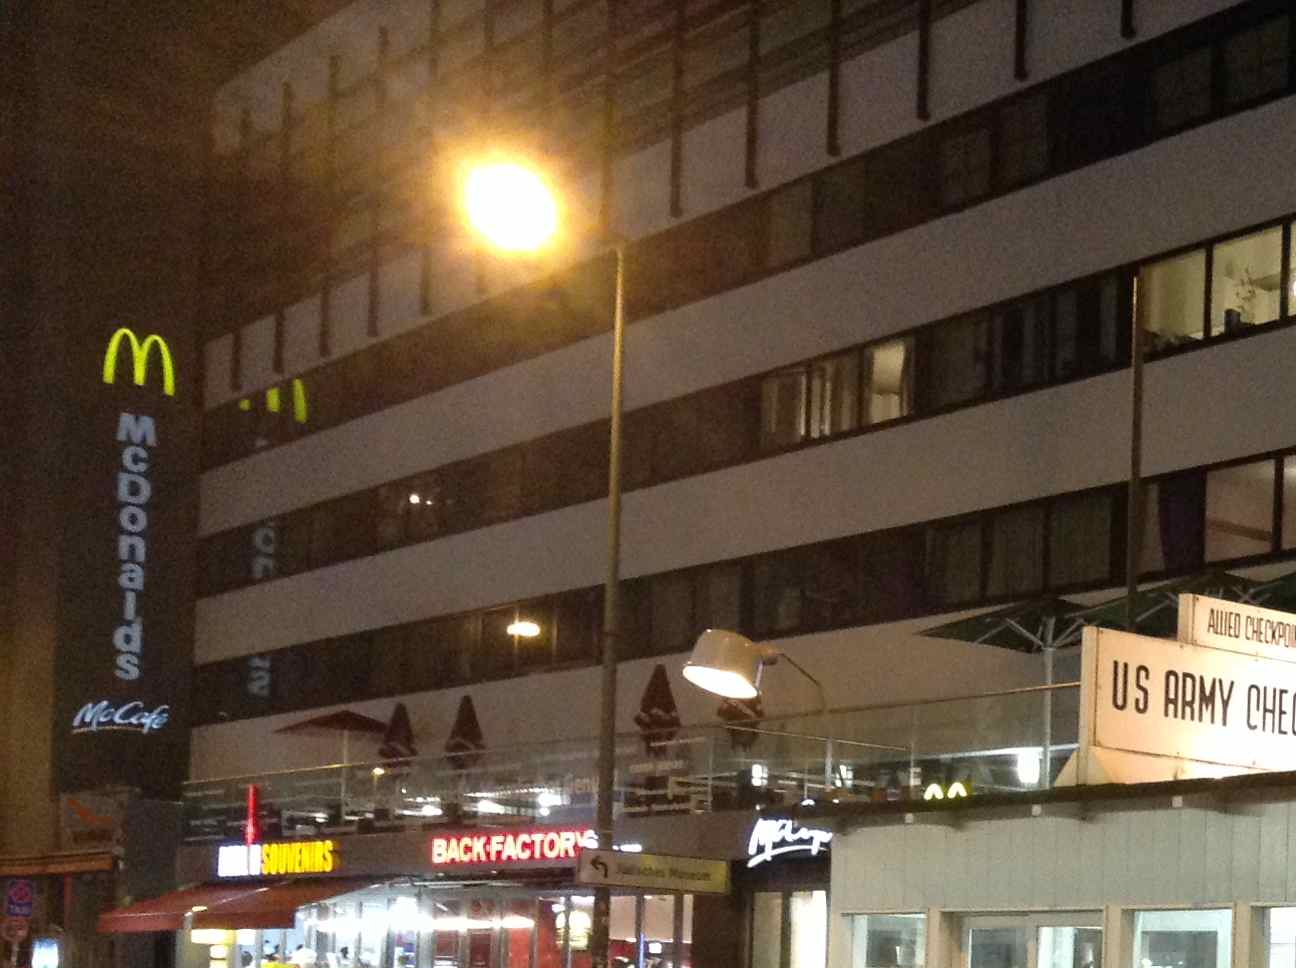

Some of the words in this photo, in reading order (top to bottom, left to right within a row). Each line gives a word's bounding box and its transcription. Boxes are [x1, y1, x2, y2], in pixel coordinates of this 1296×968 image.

[1207, 608, 1241, 638] ALLIED
[1112, 660, 1150, 715] US
[1164, 669, 1235, 727] ARMY
